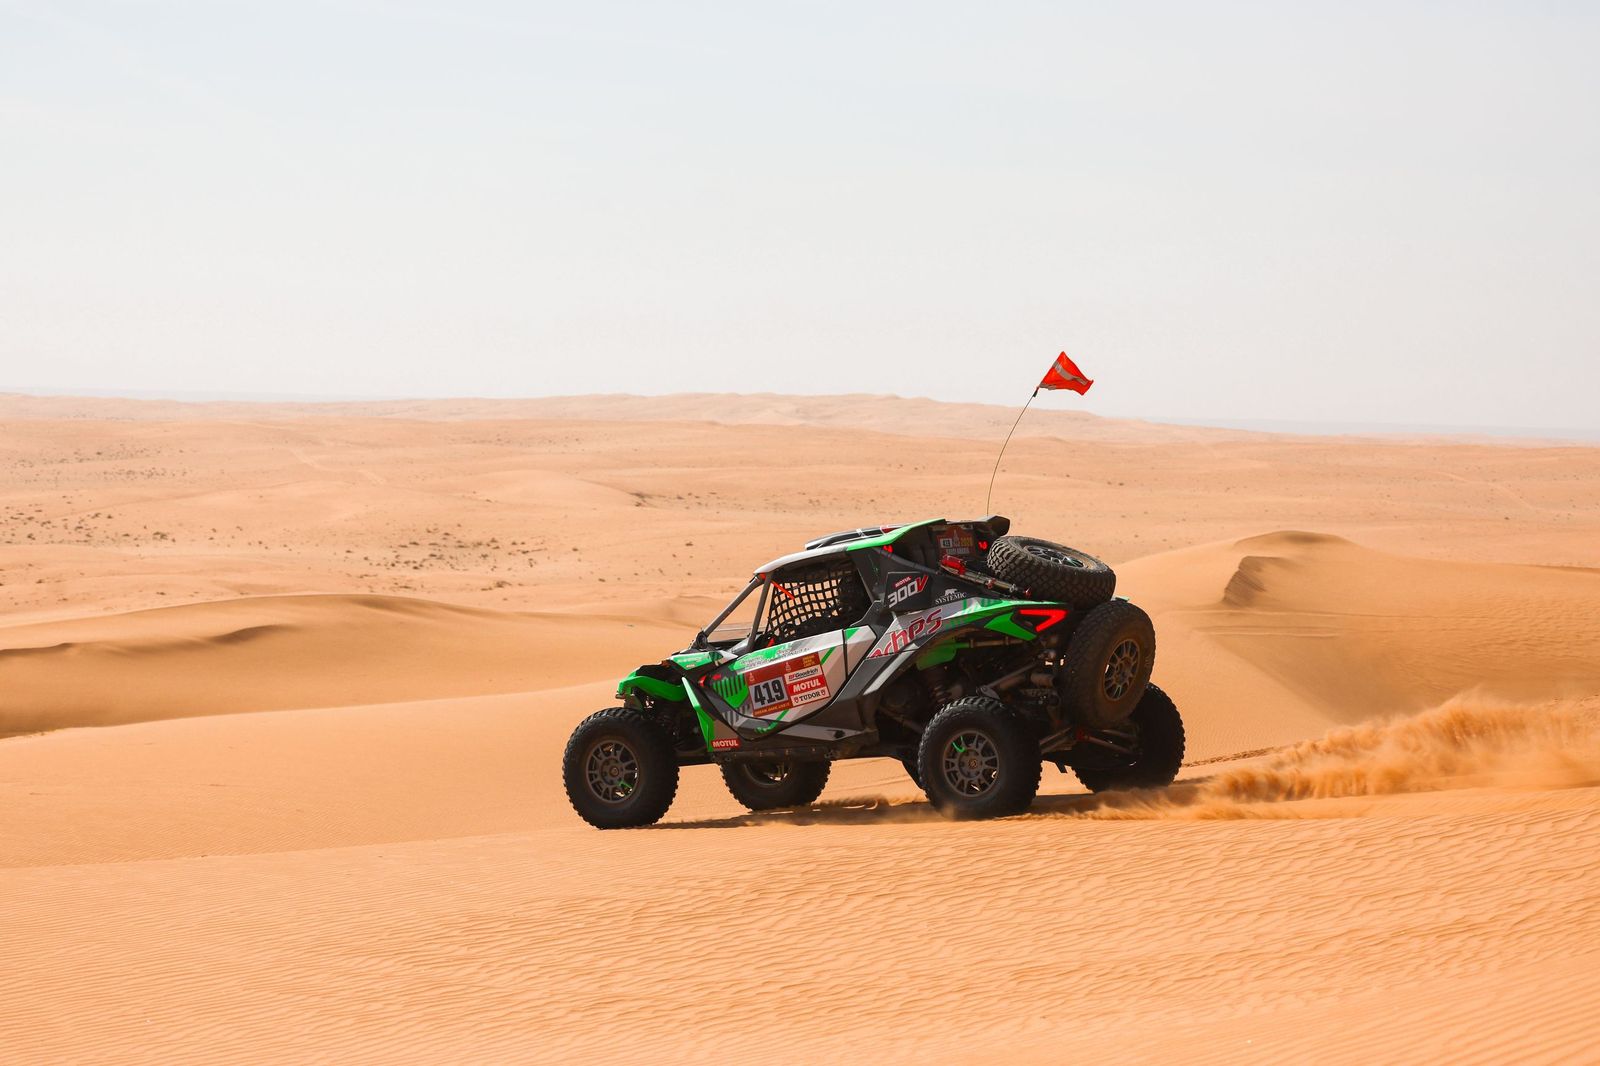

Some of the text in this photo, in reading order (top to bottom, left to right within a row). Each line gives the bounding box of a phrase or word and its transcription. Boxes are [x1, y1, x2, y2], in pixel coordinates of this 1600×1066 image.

[895, 577, 911, 588] MOTUL
[887, 575, 928, 608] 300V
[935, 593, 967, 605] SYSTEMIC
[788, 667, 819, 680] BFGoodrich
[793, 678, 822, 693] MOTUL
[754, 679, 785, 706] 419
[799, 690, 821, 702] TUDOR
[712, 739, 739, 748] MOTUL
